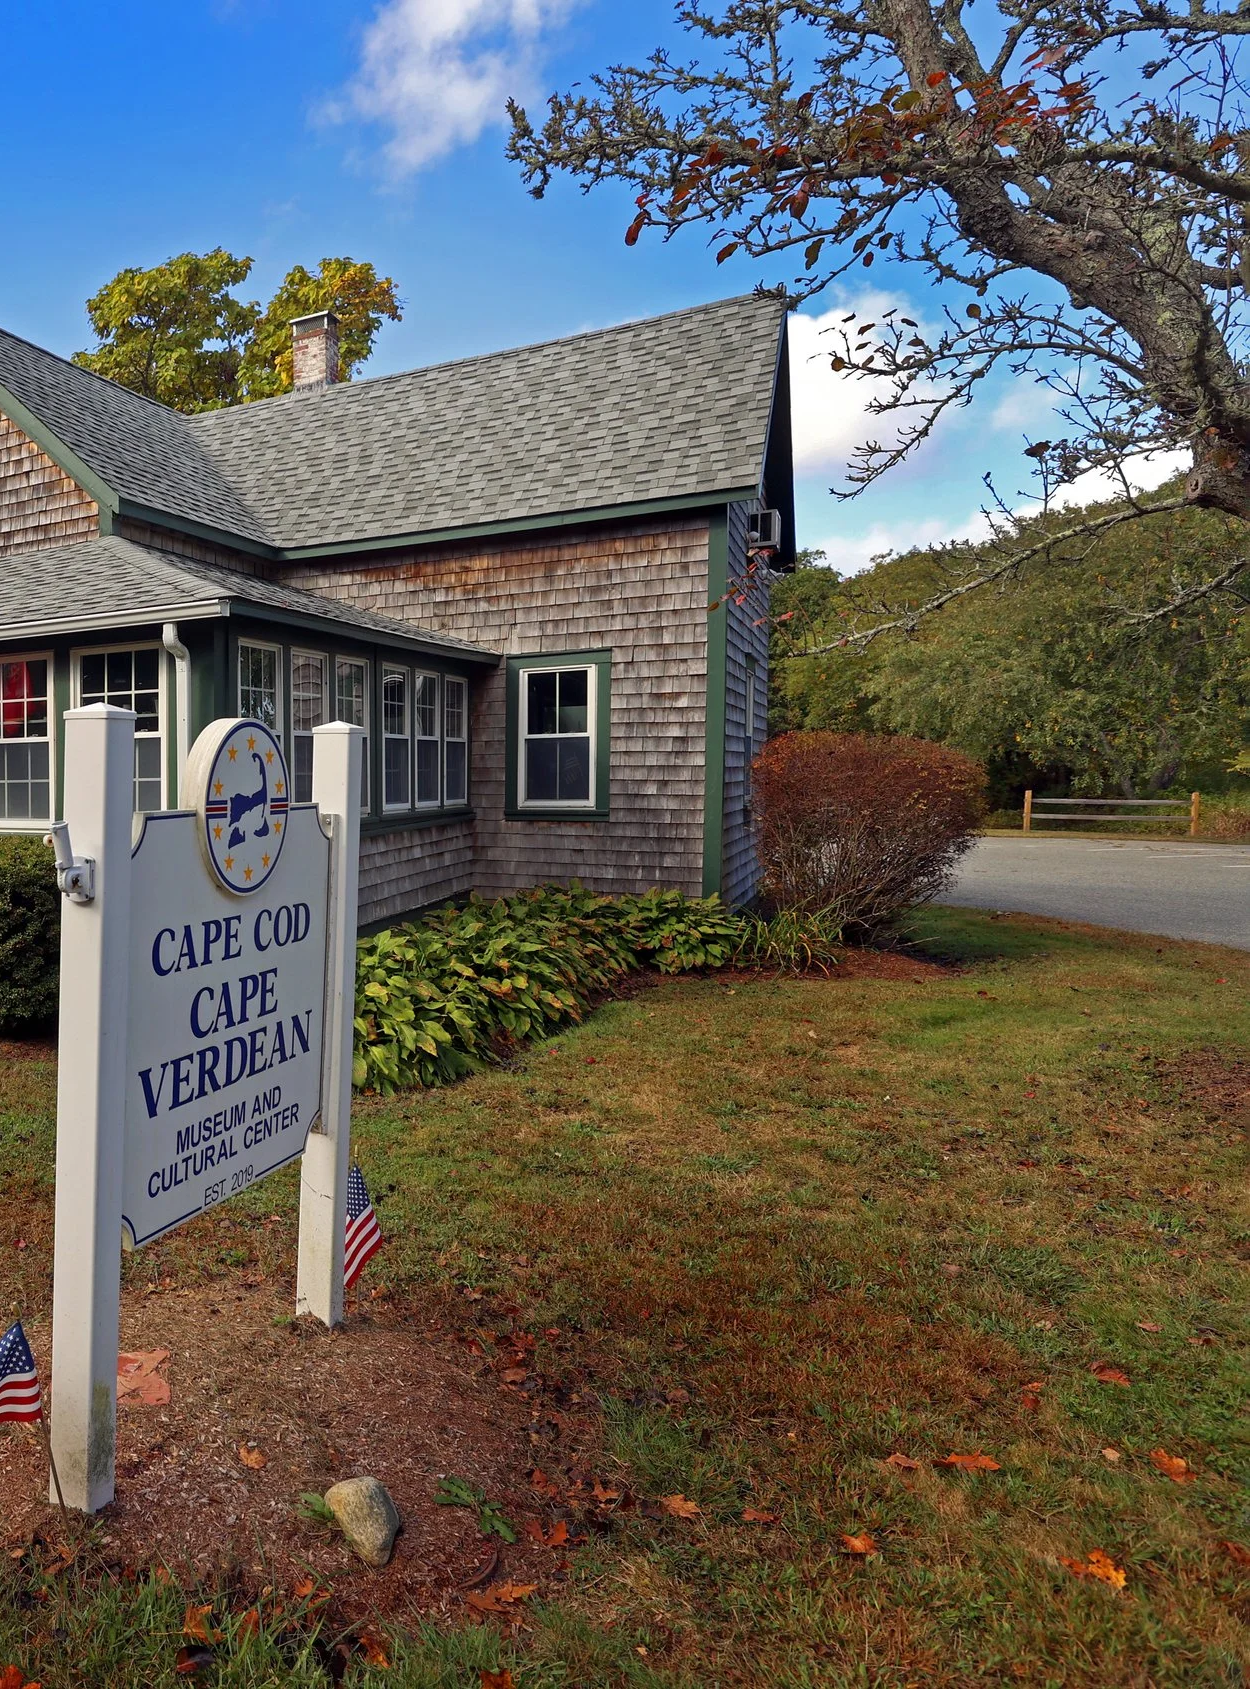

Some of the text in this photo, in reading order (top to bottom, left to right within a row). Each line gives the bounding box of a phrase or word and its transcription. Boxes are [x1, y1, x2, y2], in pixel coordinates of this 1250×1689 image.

[151, 902, 311, 977] CAPE COD
[190, 967, 279, 1039] CAPE
[137, 1009, 313, 1120] VERDEAN
[147, 1102, 300, 1199] CULTURAL CENTER
[176, 1085, 282, 1155] MUSEUM AND
[203, 1164, 254, 1207] EST. 2019
